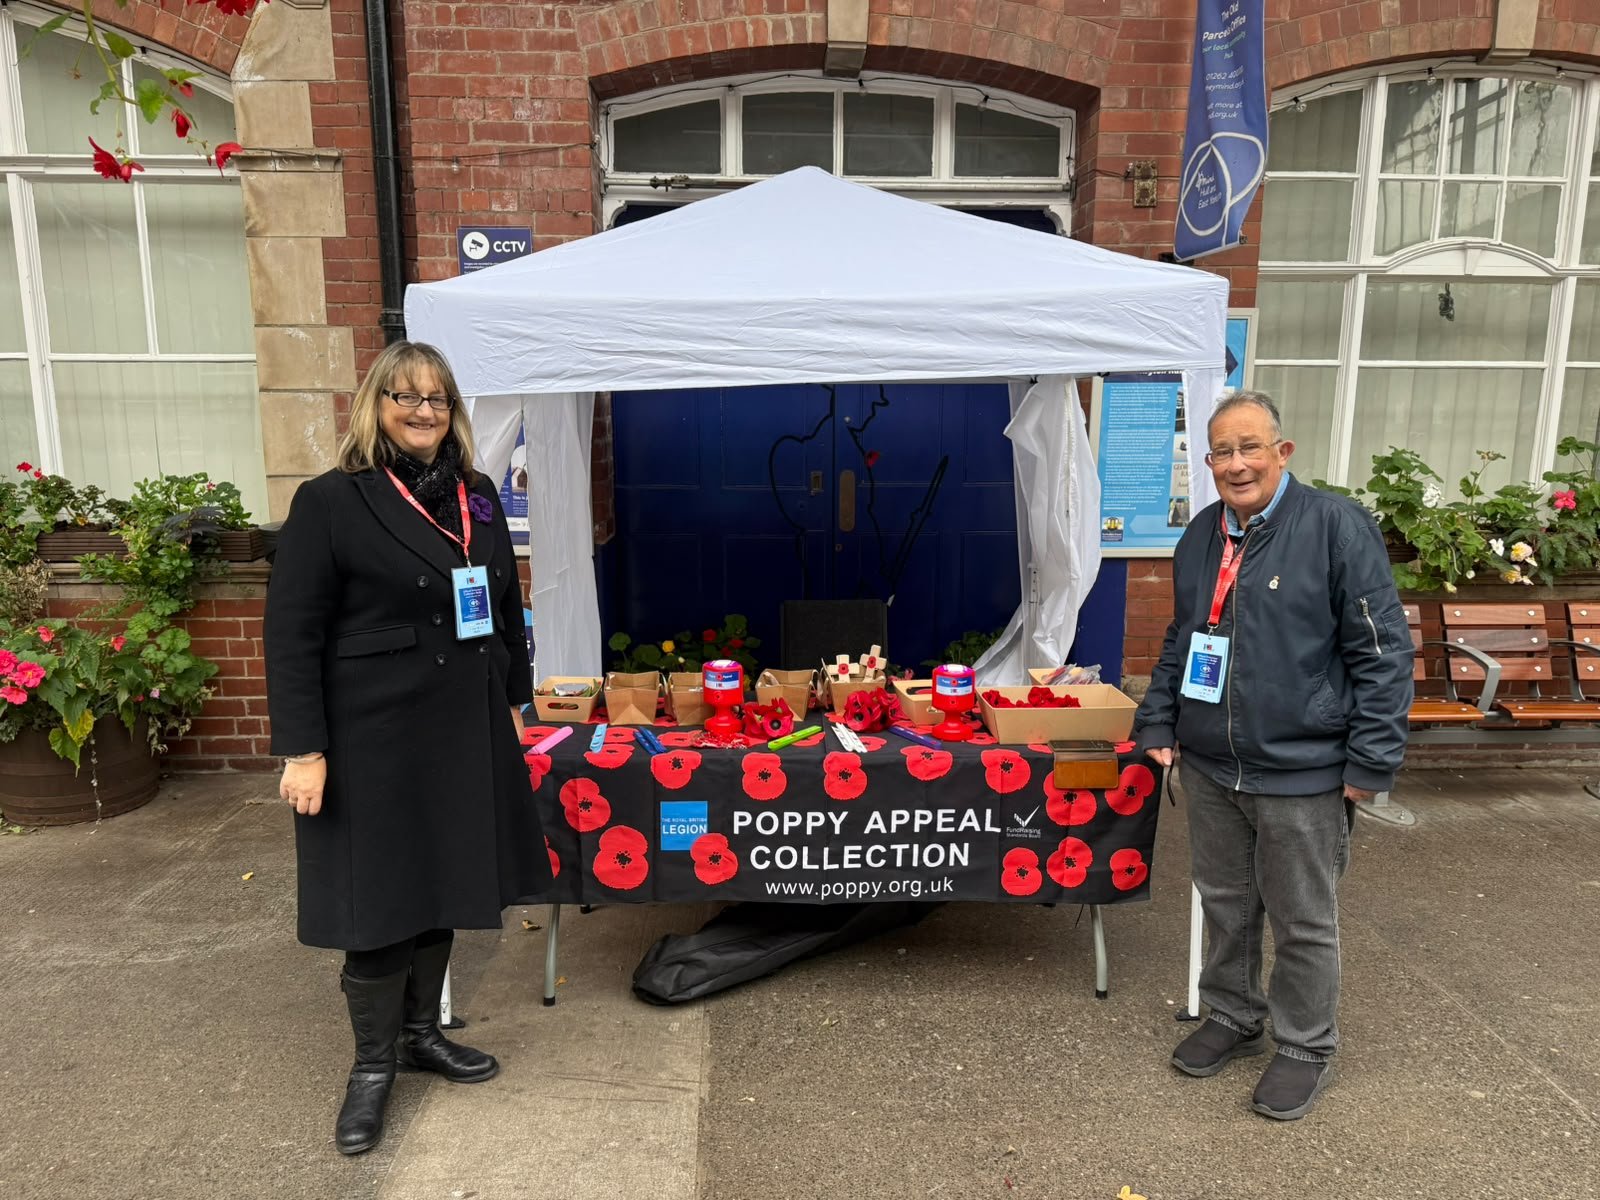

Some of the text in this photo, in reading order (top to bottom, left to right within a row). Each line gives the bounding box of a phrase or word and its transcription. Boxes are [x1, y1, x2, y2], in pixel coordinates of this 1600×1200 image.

[1221, 1, 1239, 22] The Old
[1206, 72, 1227, 81] 01262
[1198, 199, 1209, 209] East
[493, 241, 526, 253] CCTV
[733, 808, 1002, 836] POPPY APPEAL
[662, 824, 707, 835] LEGION
[1006, 826, 1041, 835] FundRaising
[750, 842, 970, 870] COLLECTION
[765, 876, 954, 901] www.poppy.org.uk
